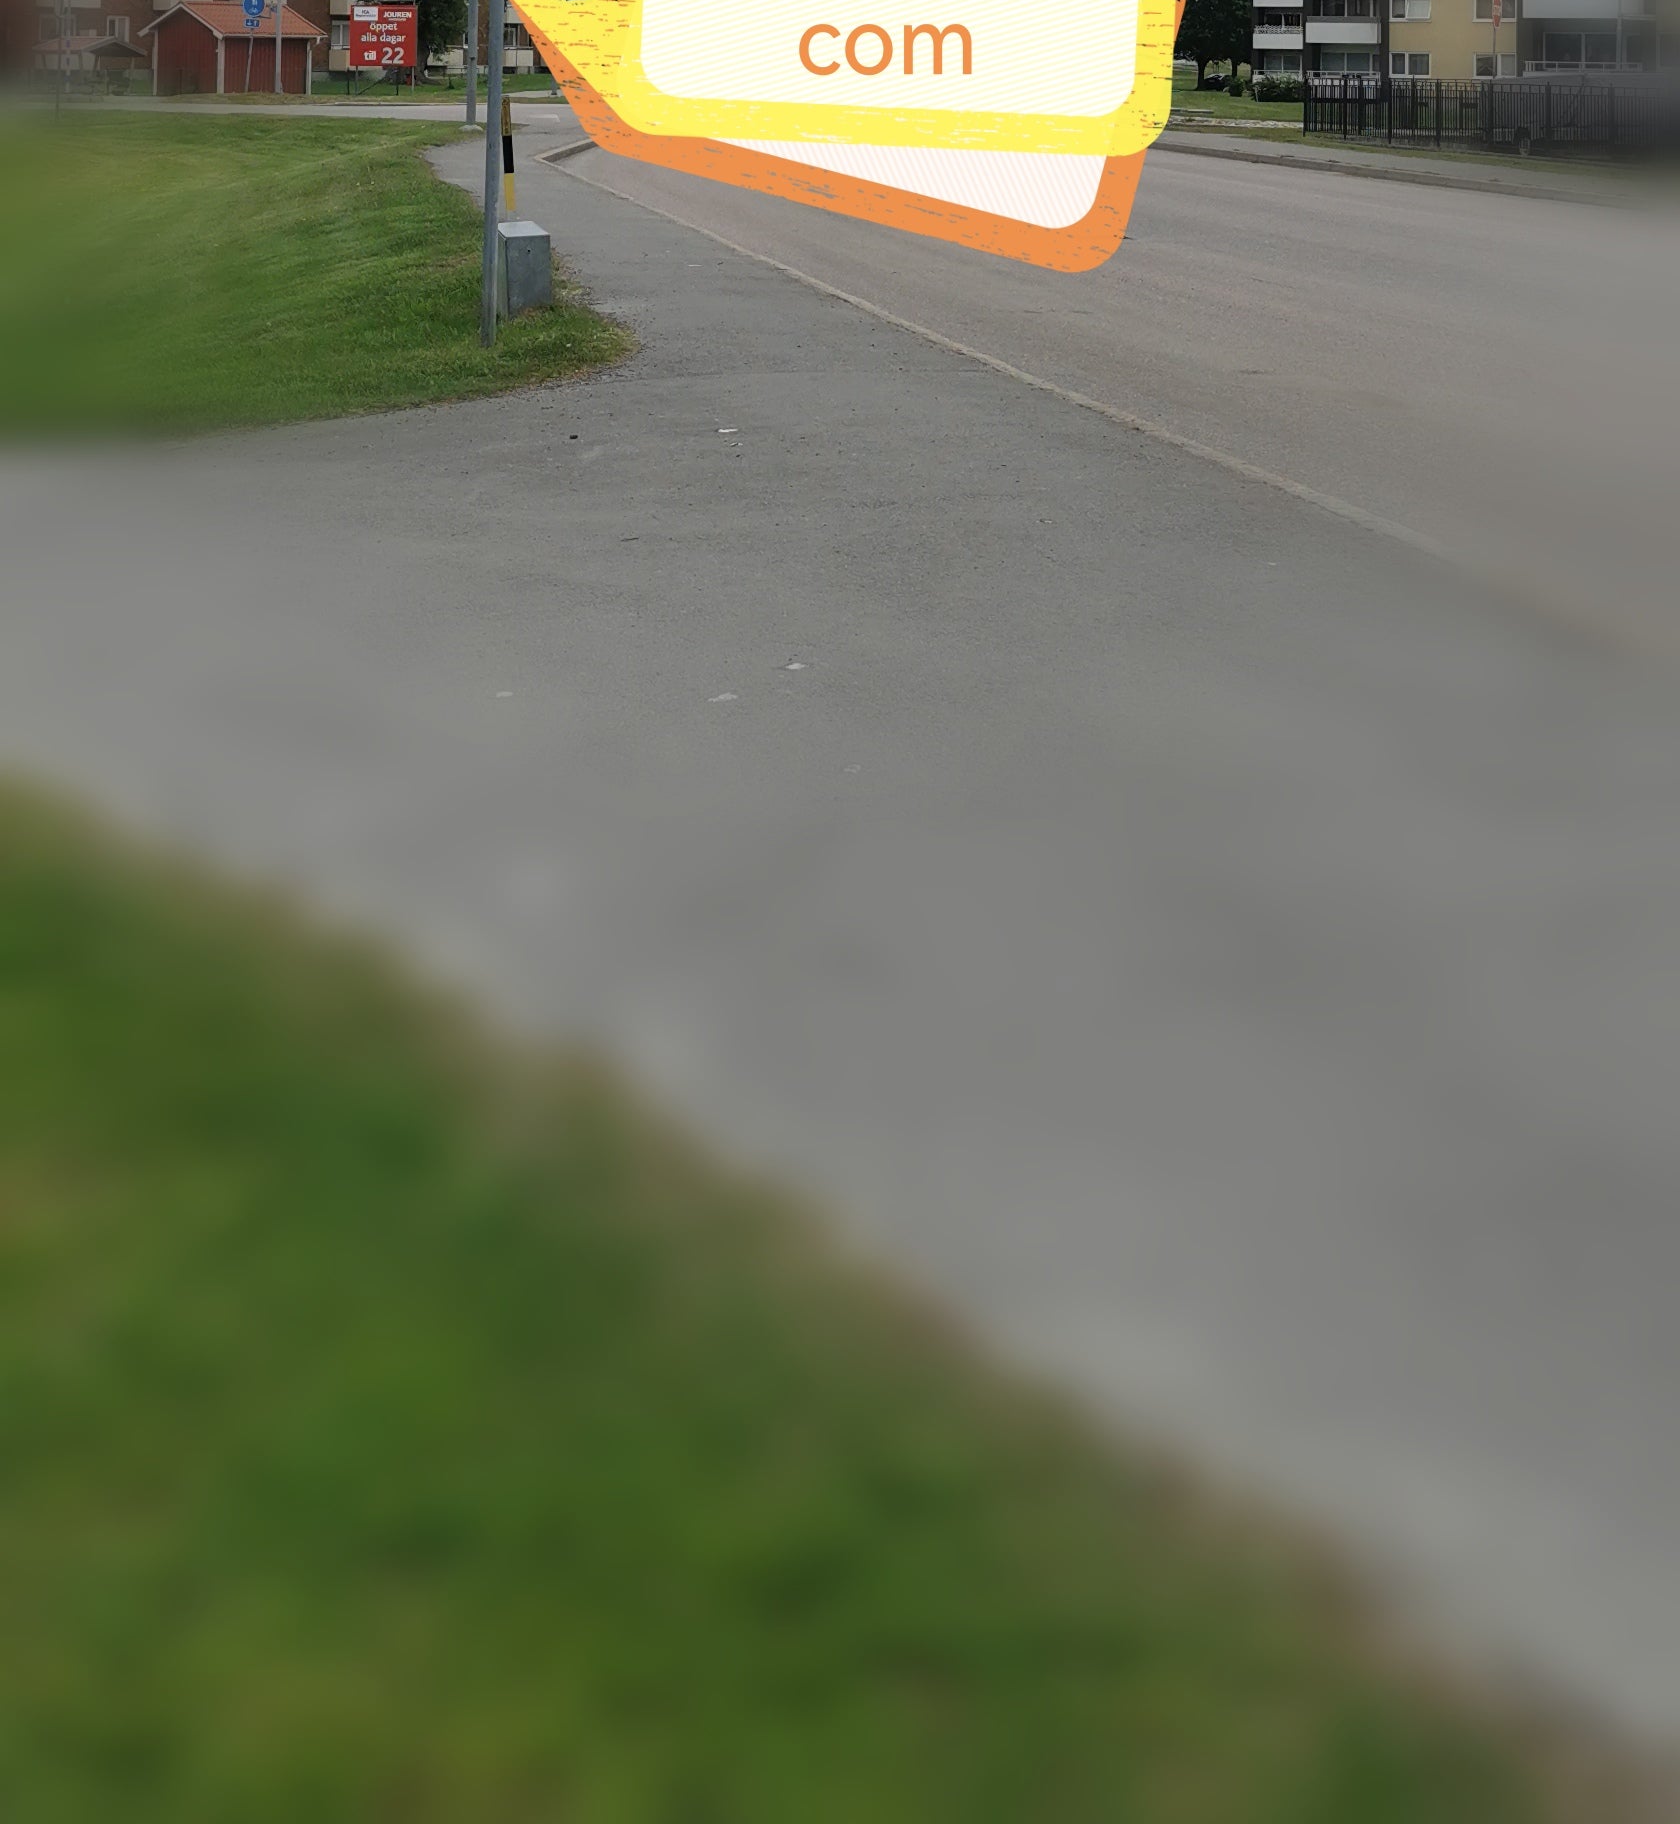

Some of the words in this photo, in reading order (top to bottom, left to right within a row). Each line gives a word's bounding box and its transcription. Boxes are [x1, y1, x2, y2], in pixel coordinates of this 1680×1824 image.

[370, 22, 397, 32] öppet
[361, 33, 377, 42] alla
[380, 33, 406, 44] dagar
[381, 47, 404, 64] 22
